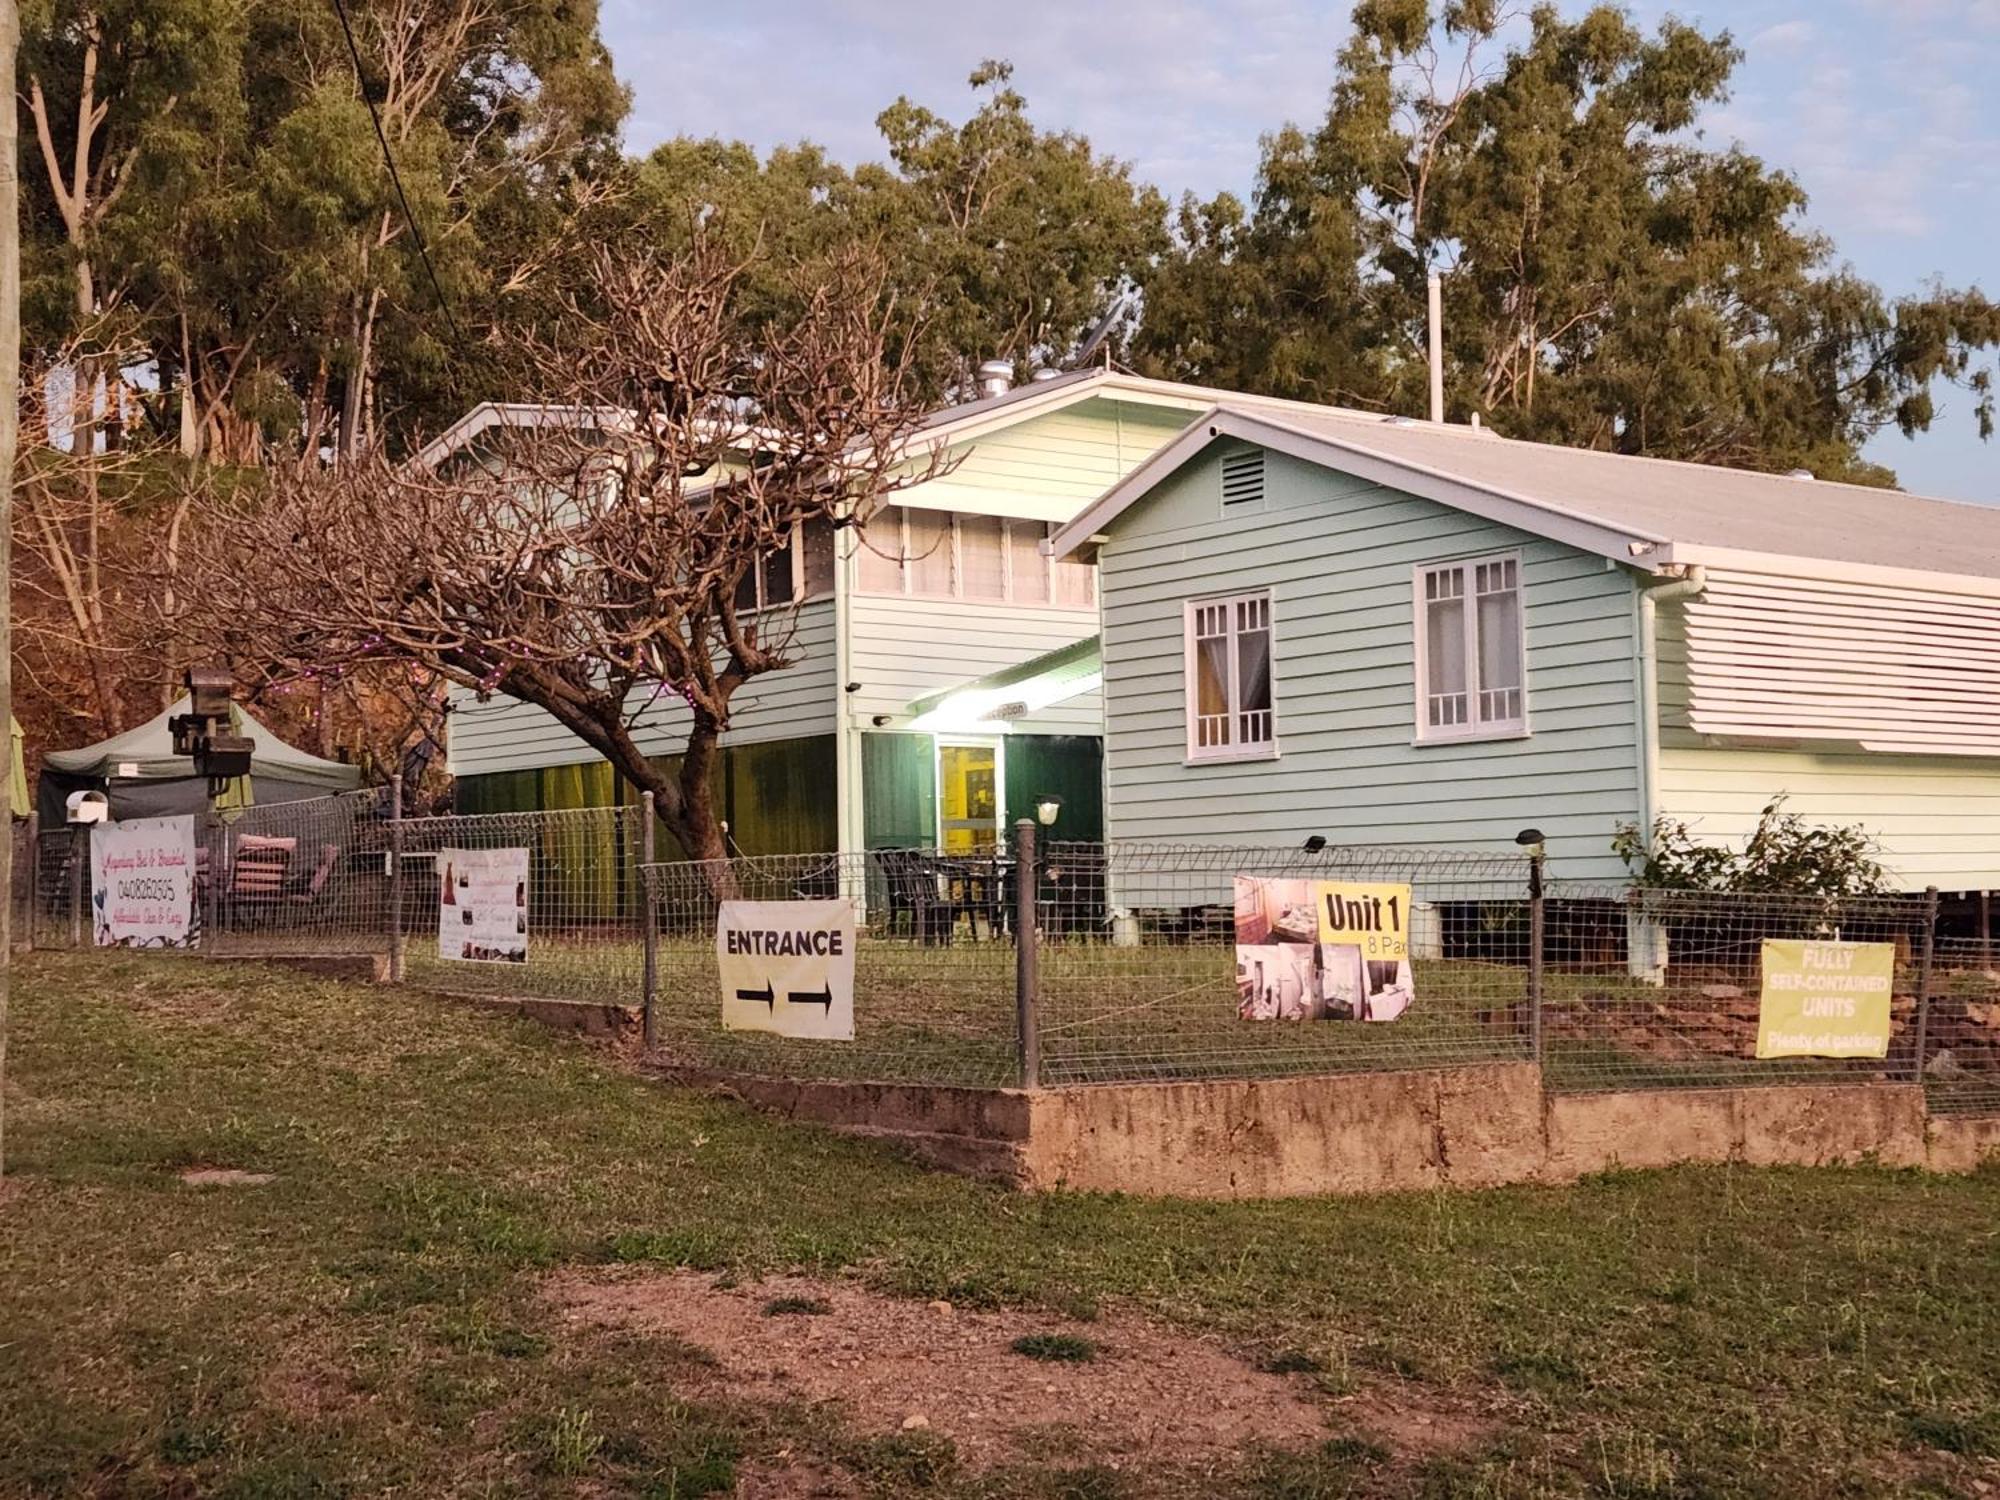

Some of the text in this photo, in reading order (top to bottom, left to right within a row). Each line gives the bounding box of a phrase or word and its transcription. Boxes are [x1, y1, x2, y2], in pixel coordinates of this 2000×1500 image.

[1326, 893, 1399, 932] Unit 1
[727, 930, 843, 956] ENTRANCE
[1367, 936, 1377, 954] 8
[1803, 948, 1854, 969] FULLY
[1770, 973, 1888, 991] SELF-CONTAINED
[1802, 997, 1856, 1017] UNITS
